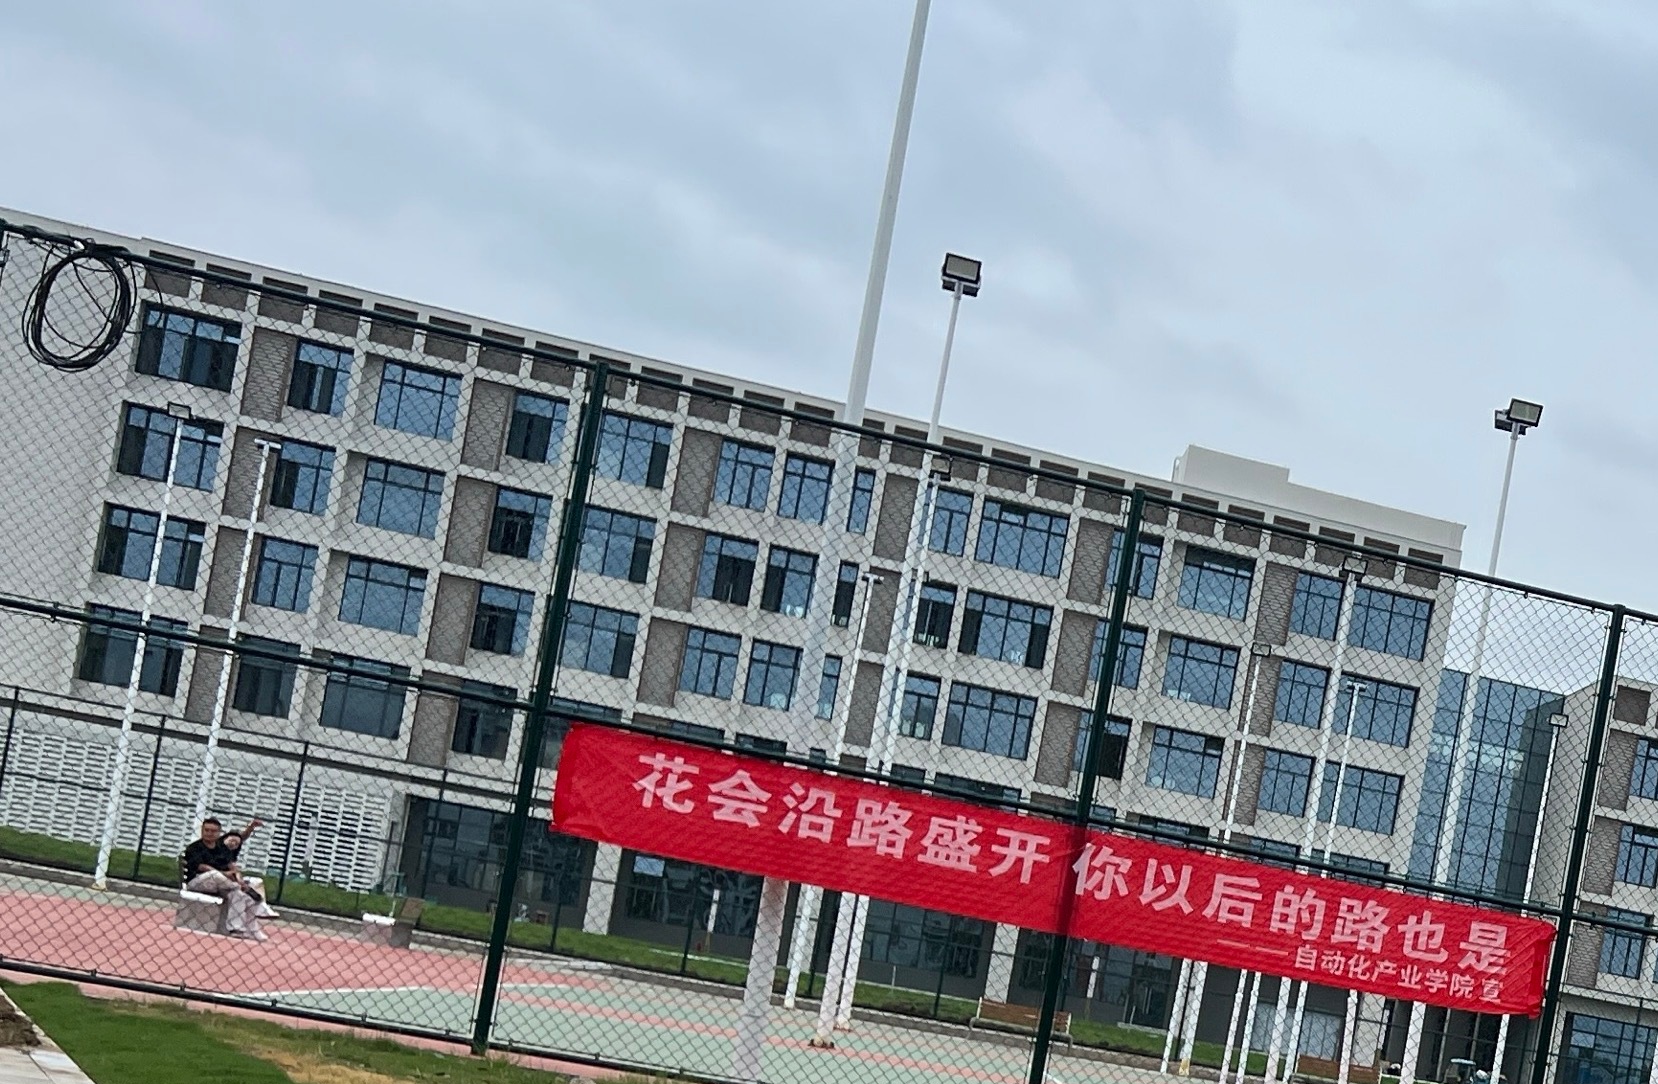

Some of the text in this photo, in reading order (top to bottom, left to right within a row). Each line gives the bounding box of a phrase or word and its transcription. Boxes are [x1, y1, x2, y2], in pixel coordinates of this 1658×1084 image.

[632, 752, 1513, 975] 花会沿路盛开 你以后的路也是
